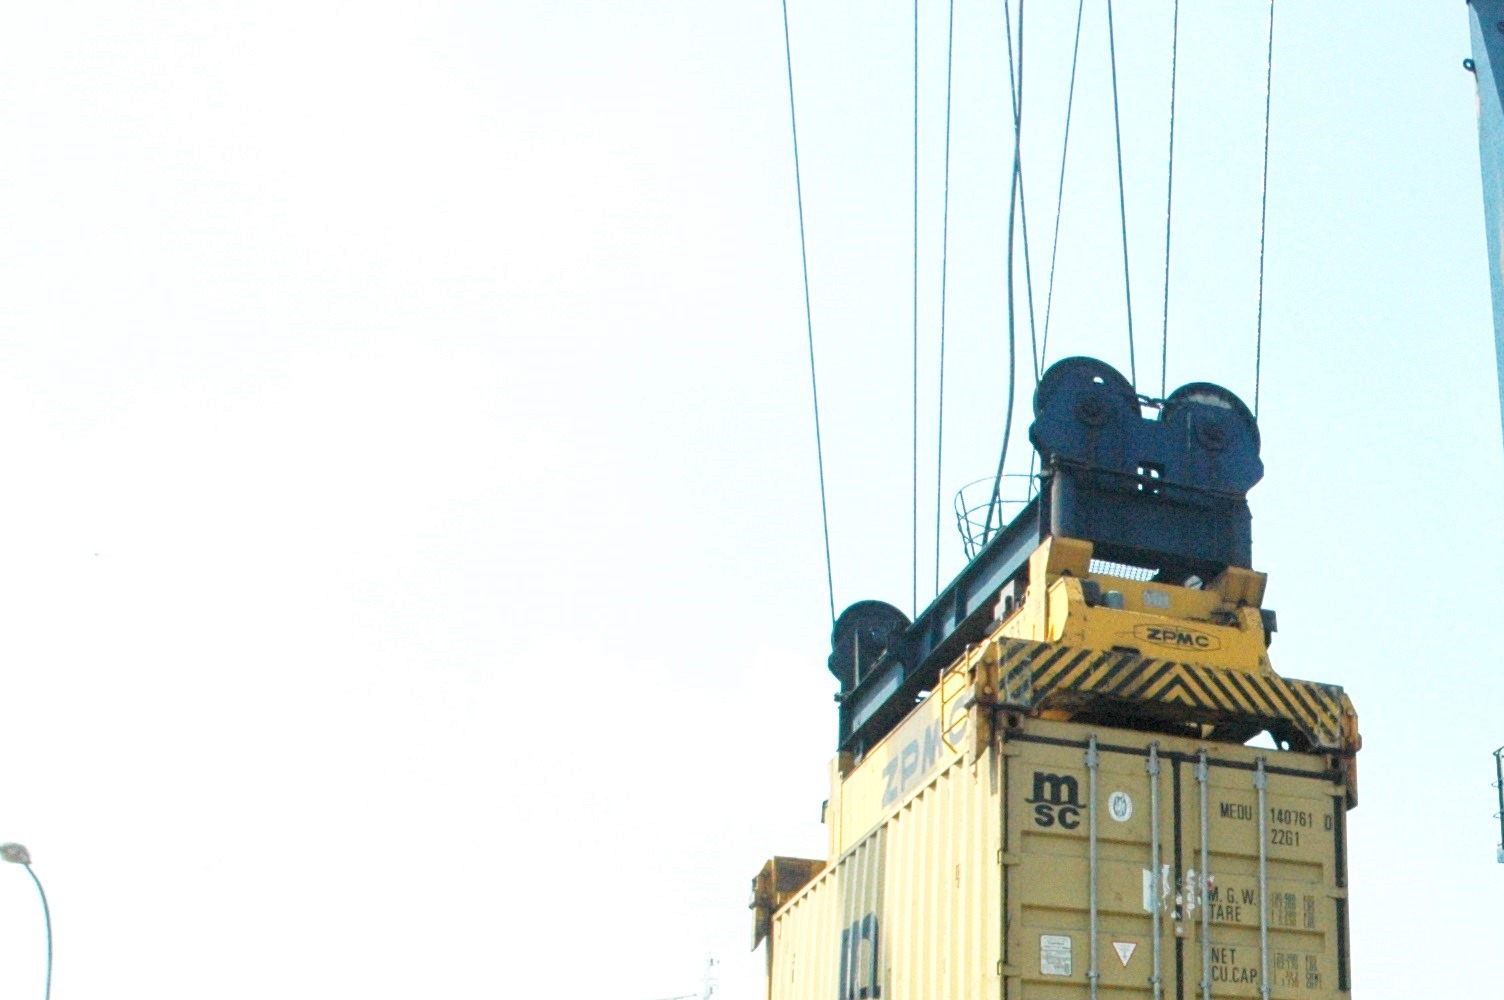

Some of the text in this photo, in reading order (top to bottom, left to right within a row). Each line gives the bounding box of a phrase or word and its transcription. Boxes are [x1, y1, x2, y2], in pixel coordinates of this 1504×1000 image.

[1146, 627, 1209, 647] ZPMC
[1220, 802, 1252, 821] MEDU
[1271, 808, 1313, 828] 140761
[1271, 829, 1300, 847] 22G1
[1209, 904, 1241, 923] TARE
[1211, 948, 1237, 964] NET
